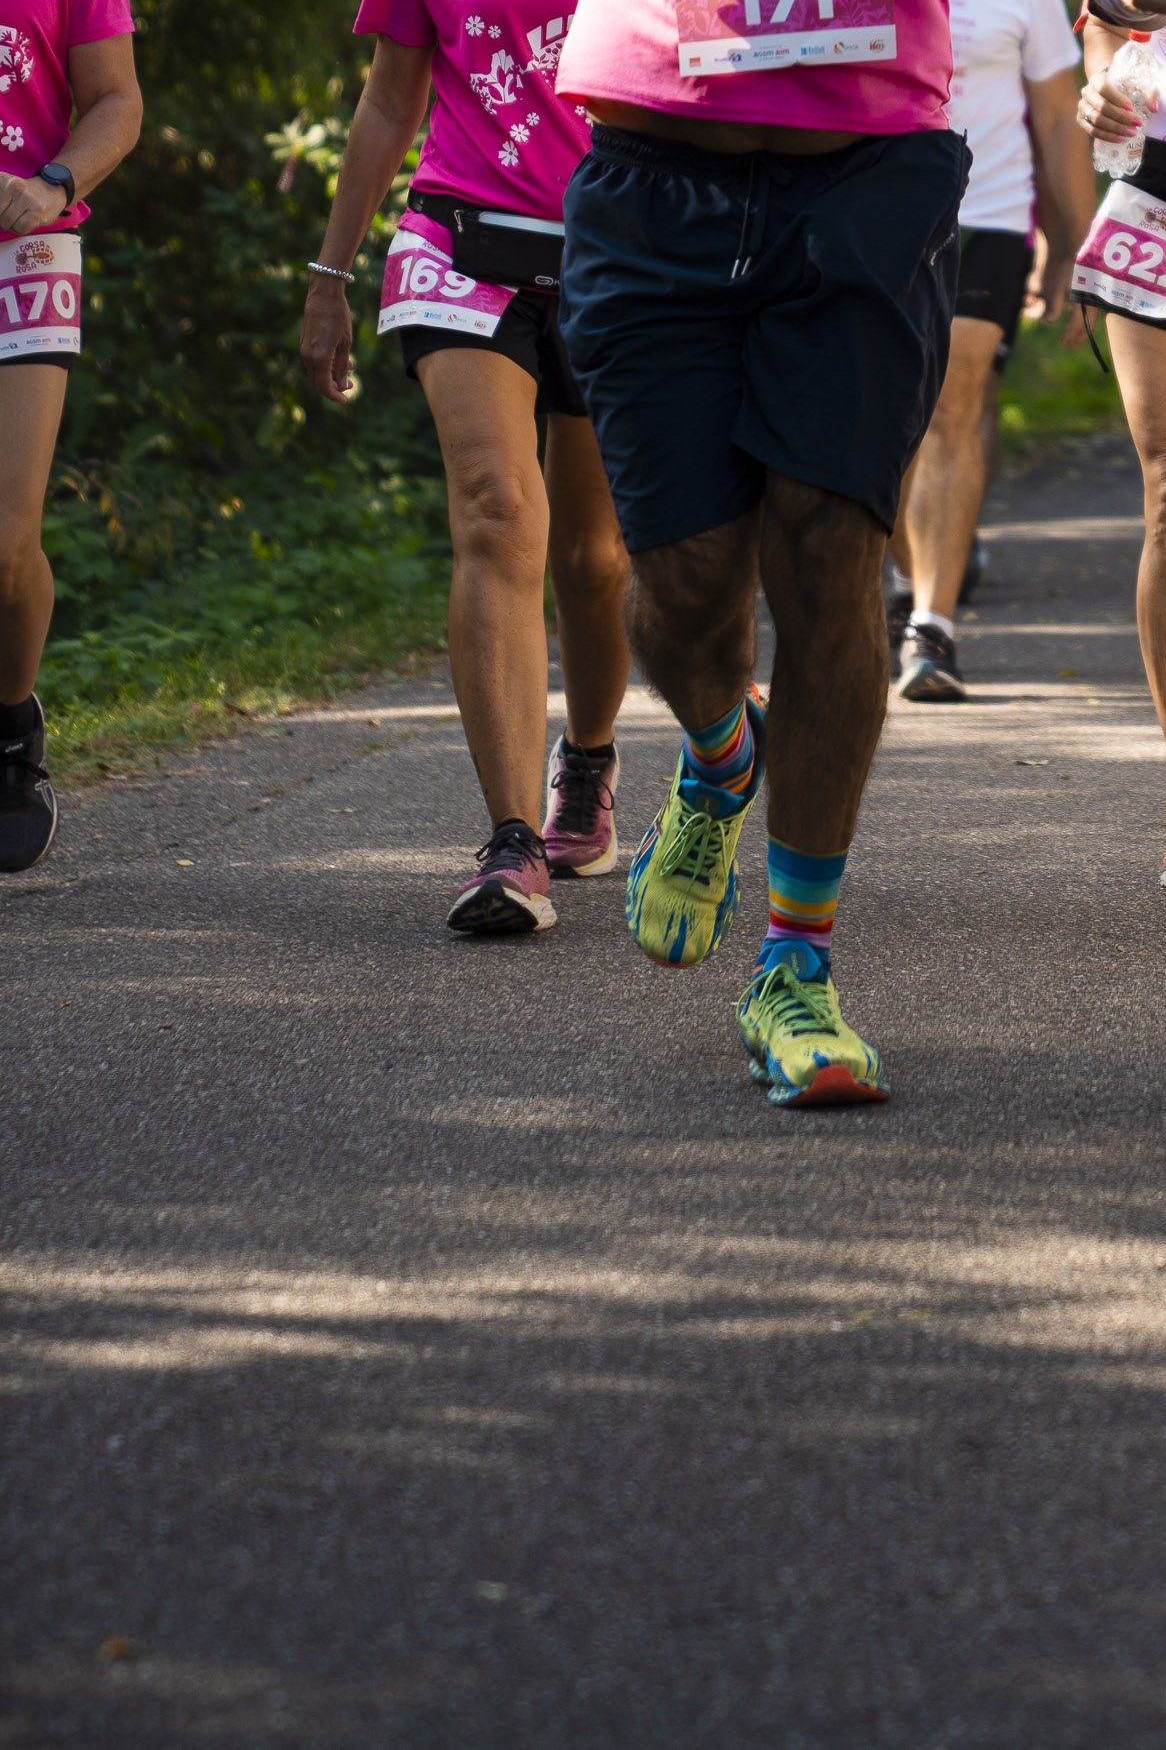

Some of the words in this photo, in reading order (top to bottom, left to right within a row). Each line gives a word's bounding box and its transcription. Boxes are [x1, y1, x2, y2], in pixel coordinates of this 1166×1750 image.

[1138, 220, 1160, 232] ROSA
[20, 240, 46, 253] CORSA
[422, 240, 442, 252] ROS
[16, 261, 38, 275] ROSA
[398, 255, 477, 299] 169
[0, 279, 77, 325] 170
